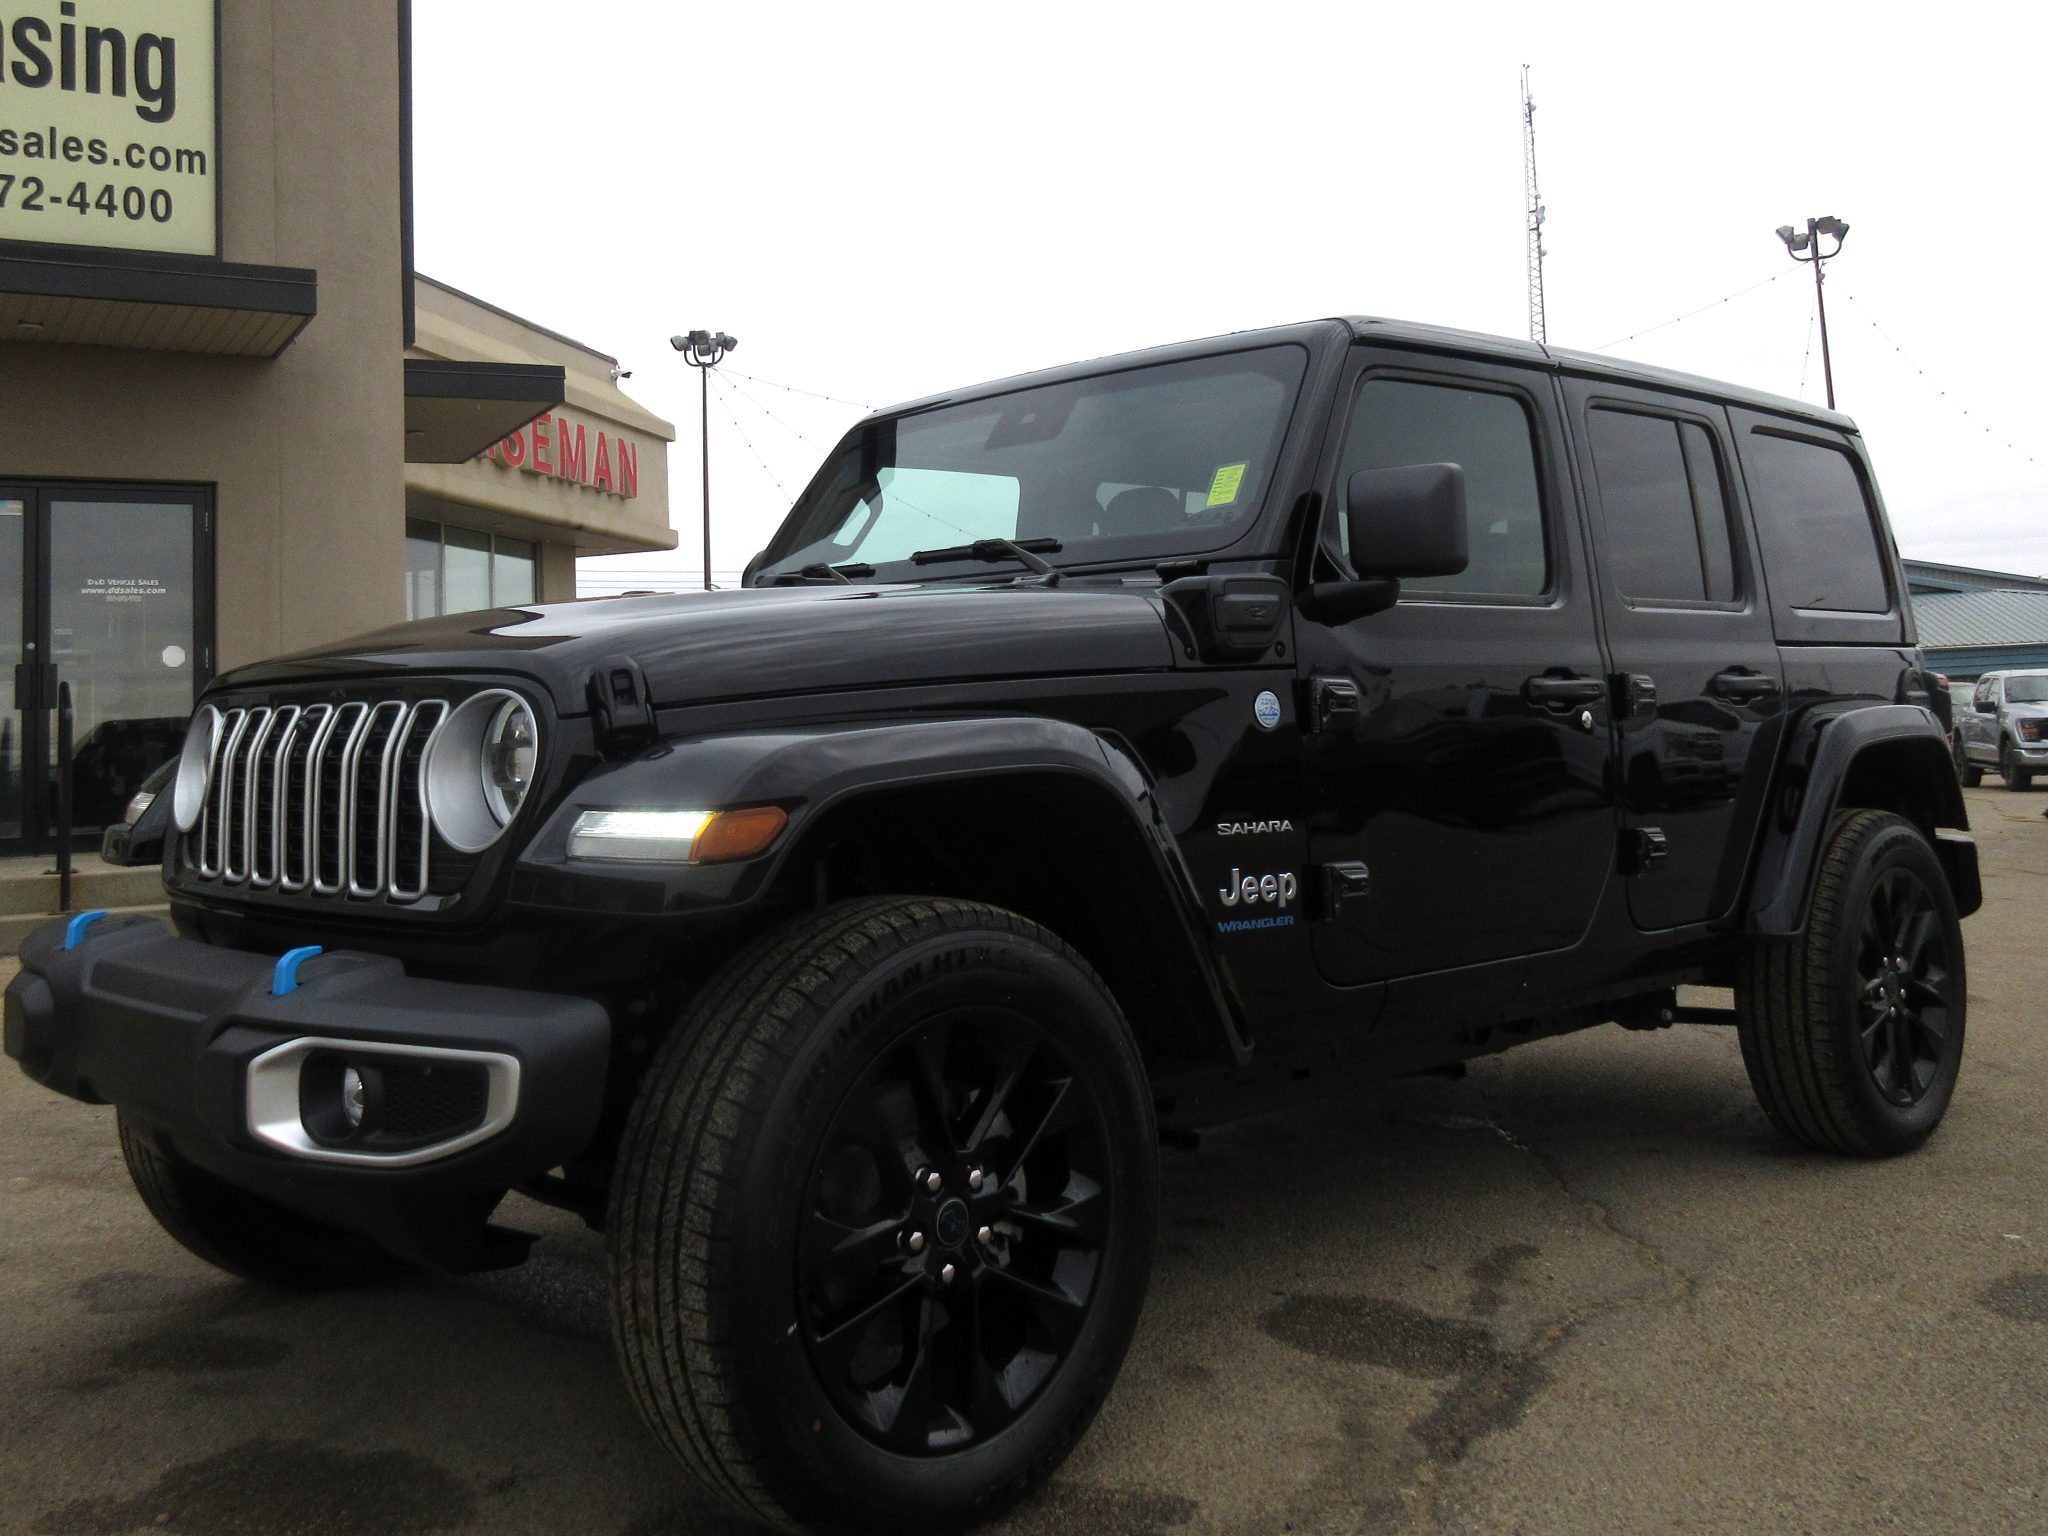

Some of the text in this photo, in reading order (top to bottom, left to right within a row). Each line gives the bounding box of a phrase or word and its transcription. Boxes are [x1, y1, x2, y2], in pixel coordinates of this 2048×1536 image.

[0, 1, 176, 123] sing
[0, 126, 207, 175] sales.com
[0, 173, 173, 222] 72-4400
[487, 412, 639, 499] SEMAN
[1217, 819, 1294, 836] SAHARA
[1219, 867, 1297, 908] Jeep
[1217, 915, 1296, 933] WRANGLER
